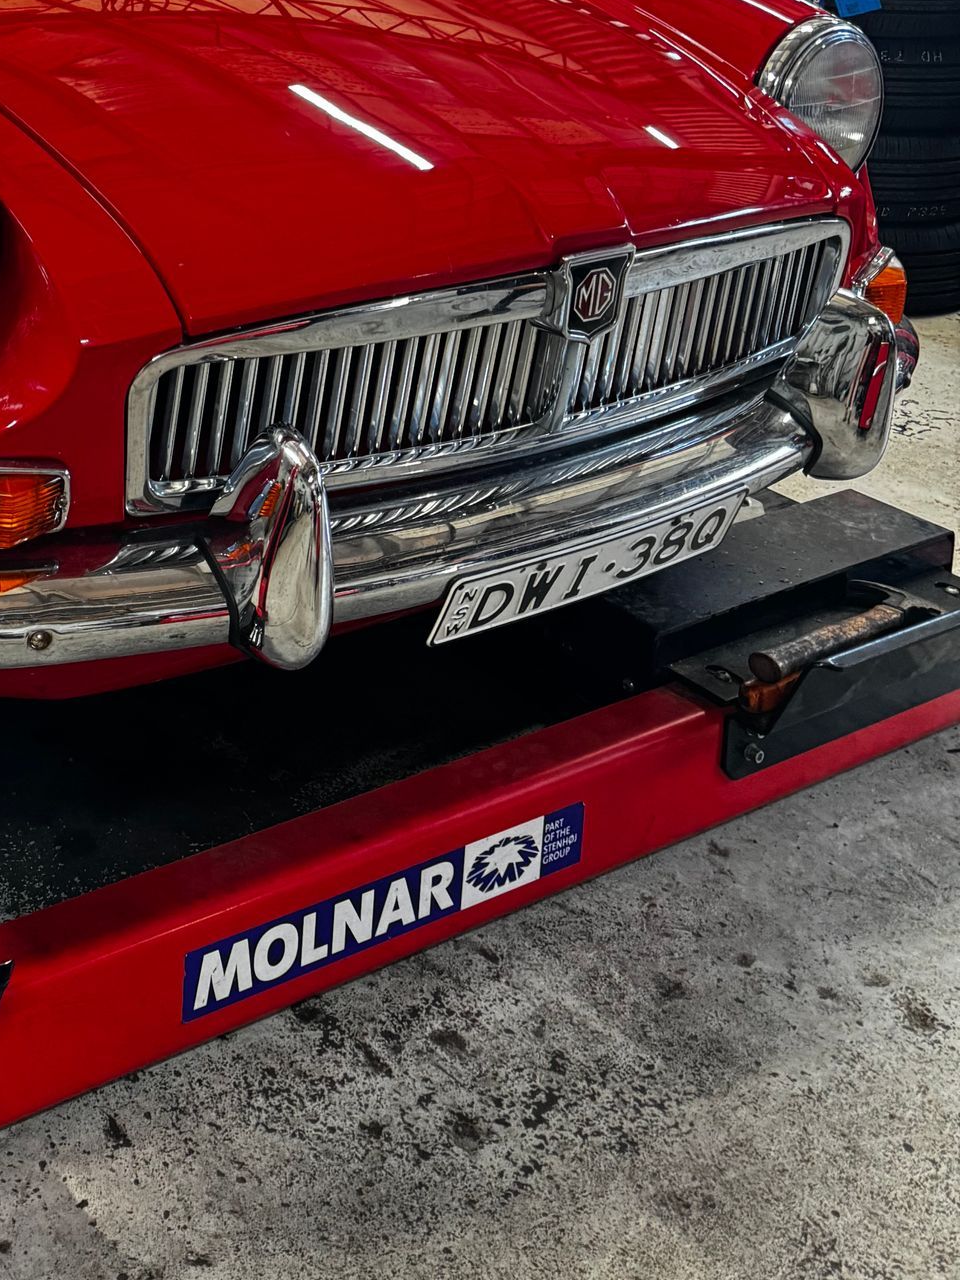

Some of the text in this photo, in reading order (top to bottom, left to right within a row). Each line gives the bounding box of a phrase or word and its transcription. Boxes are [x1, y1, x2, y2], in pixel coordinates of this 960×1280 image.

[578, 273, 613, 316] MG
[544, 825, 571, 843] OF THE
[545, 817, 565, 833] PART
[543, 833, 578, 855] STENHØJ
[542, 846, 571, 865] GROUP
[193, 860, 455, 1011] MOLNAR
